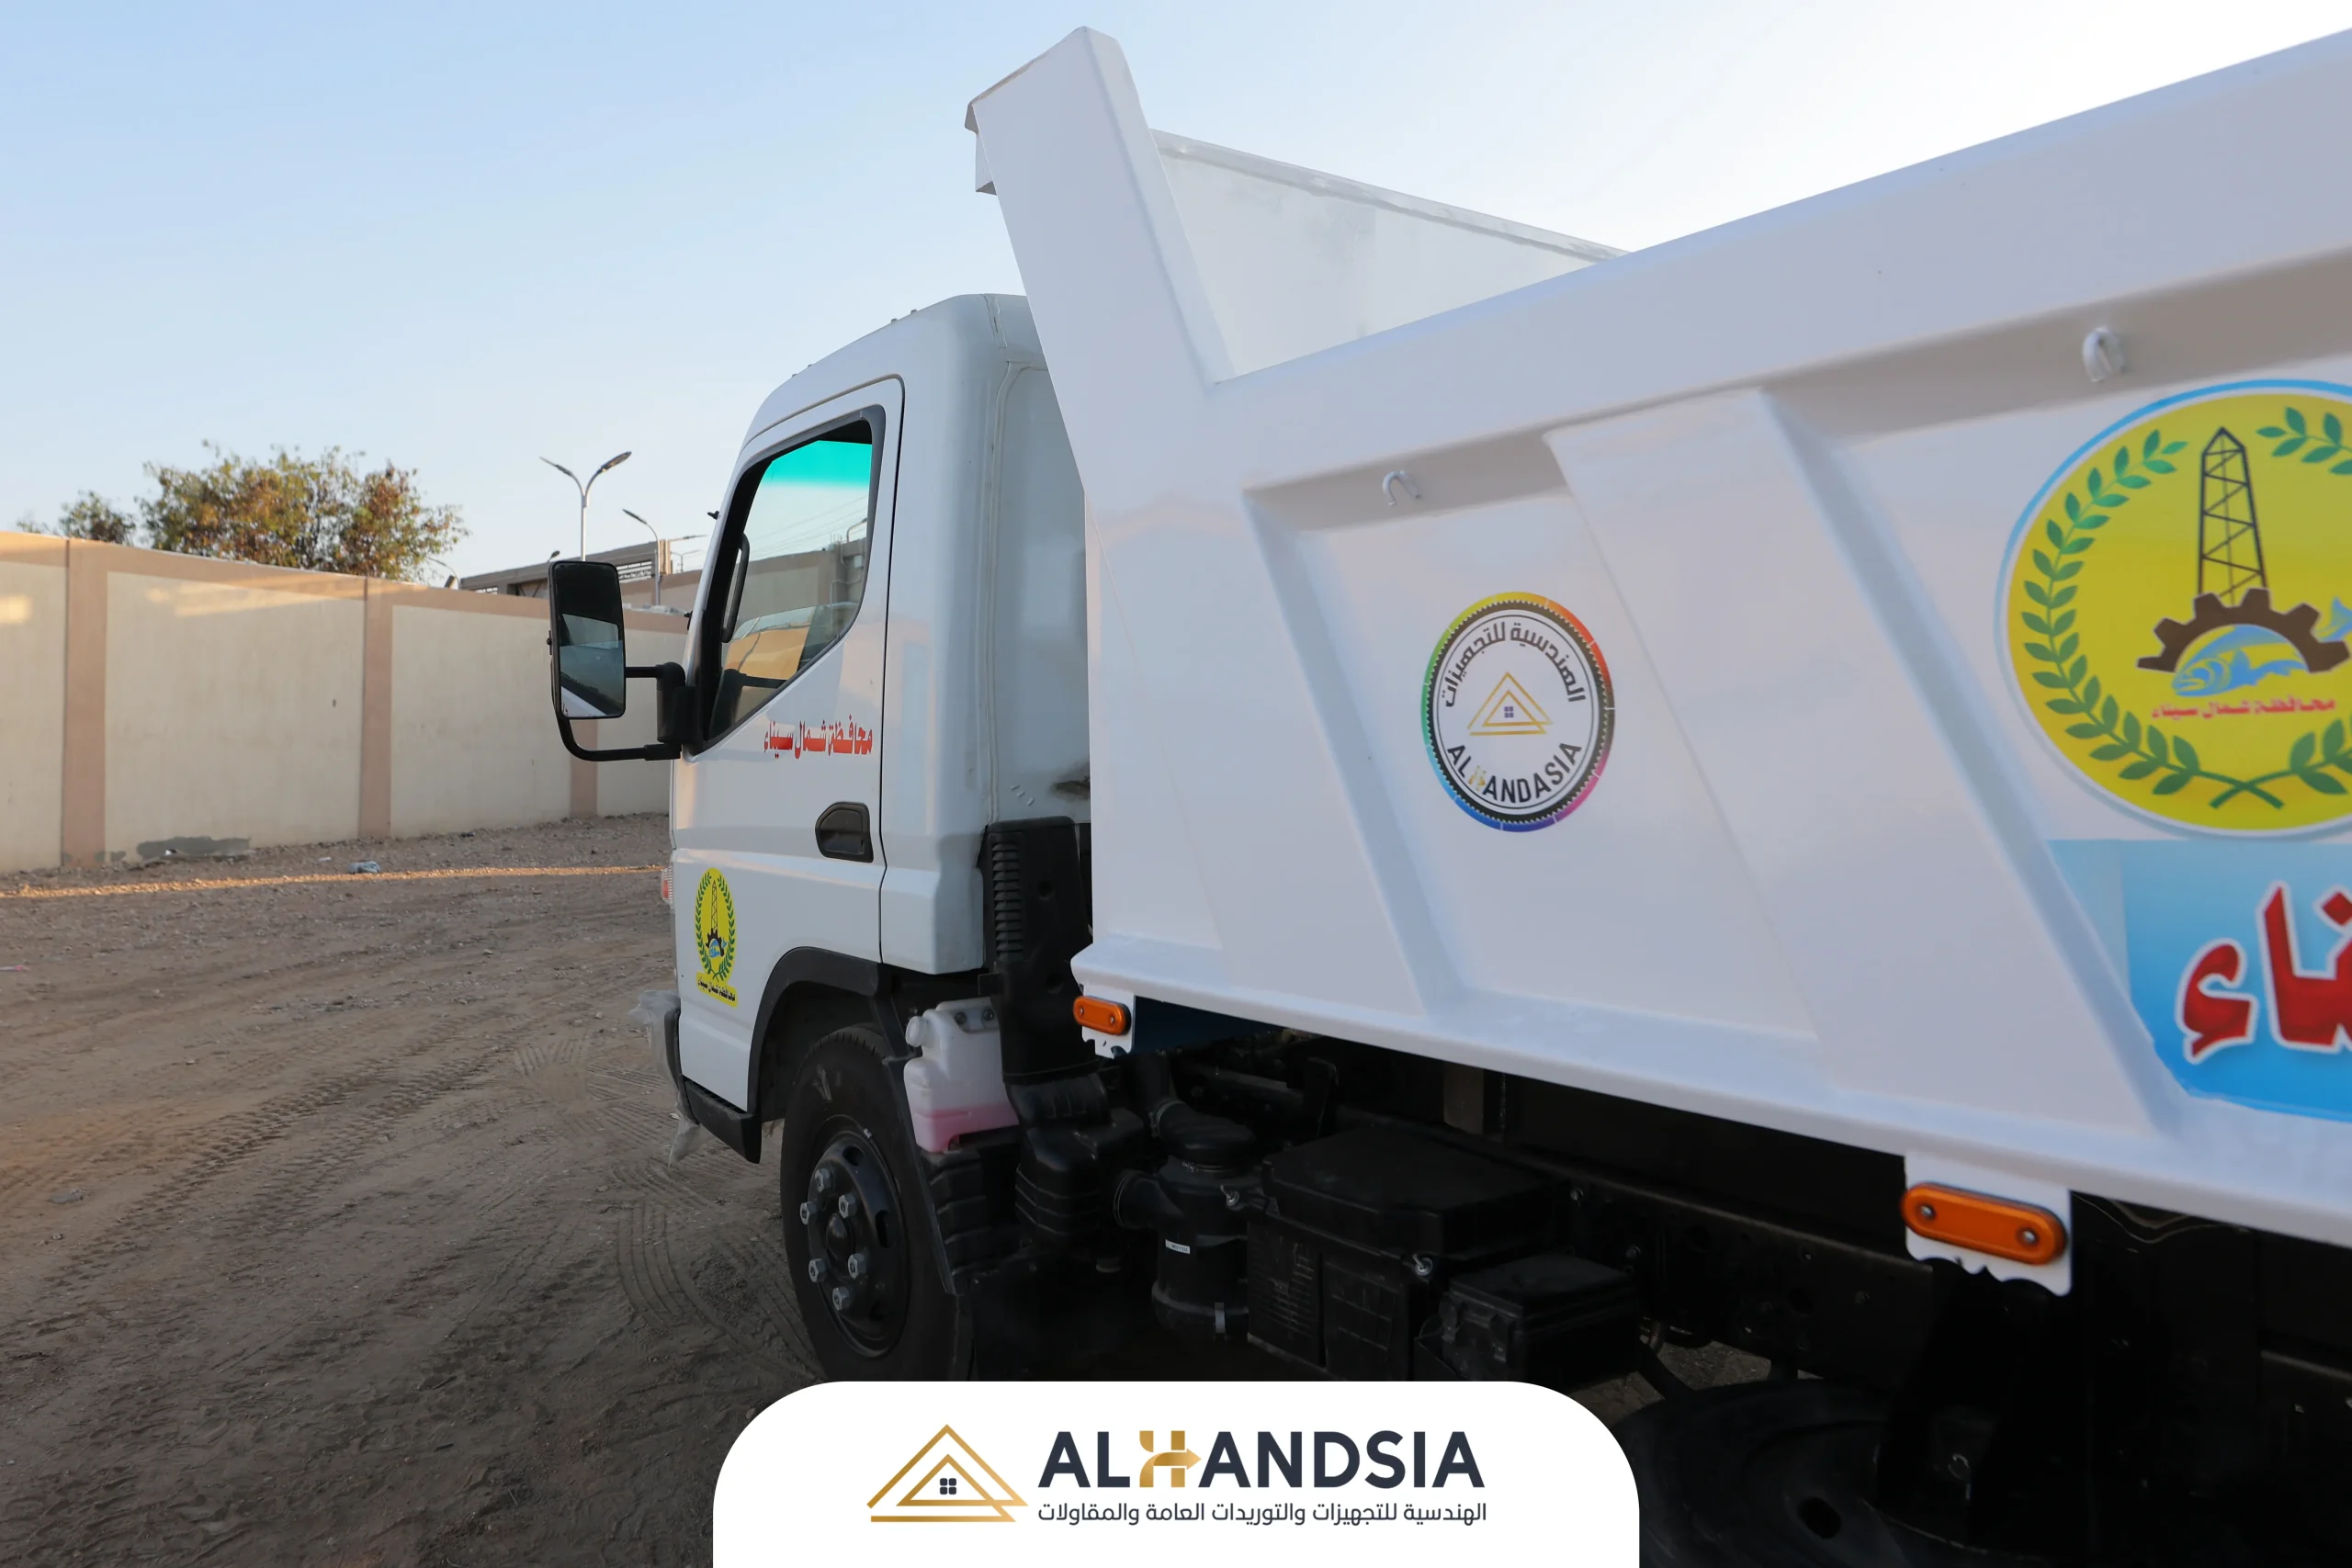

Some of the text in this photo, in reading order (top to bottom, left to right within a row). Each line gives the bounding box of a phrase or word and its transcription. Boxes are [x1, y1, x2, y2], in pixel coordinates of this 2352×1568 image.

[1441, 621, 1587, 707] الهندسية للتجهيزات
[763, 714, 873, 760] محافظة شمال سيناء
[2151, 695, 2335, 720] محافظة شمال سيناء
[1446, 742, 1582, 804] ALHANDASIA
[2176, 882, 2352, 1063] ناء
